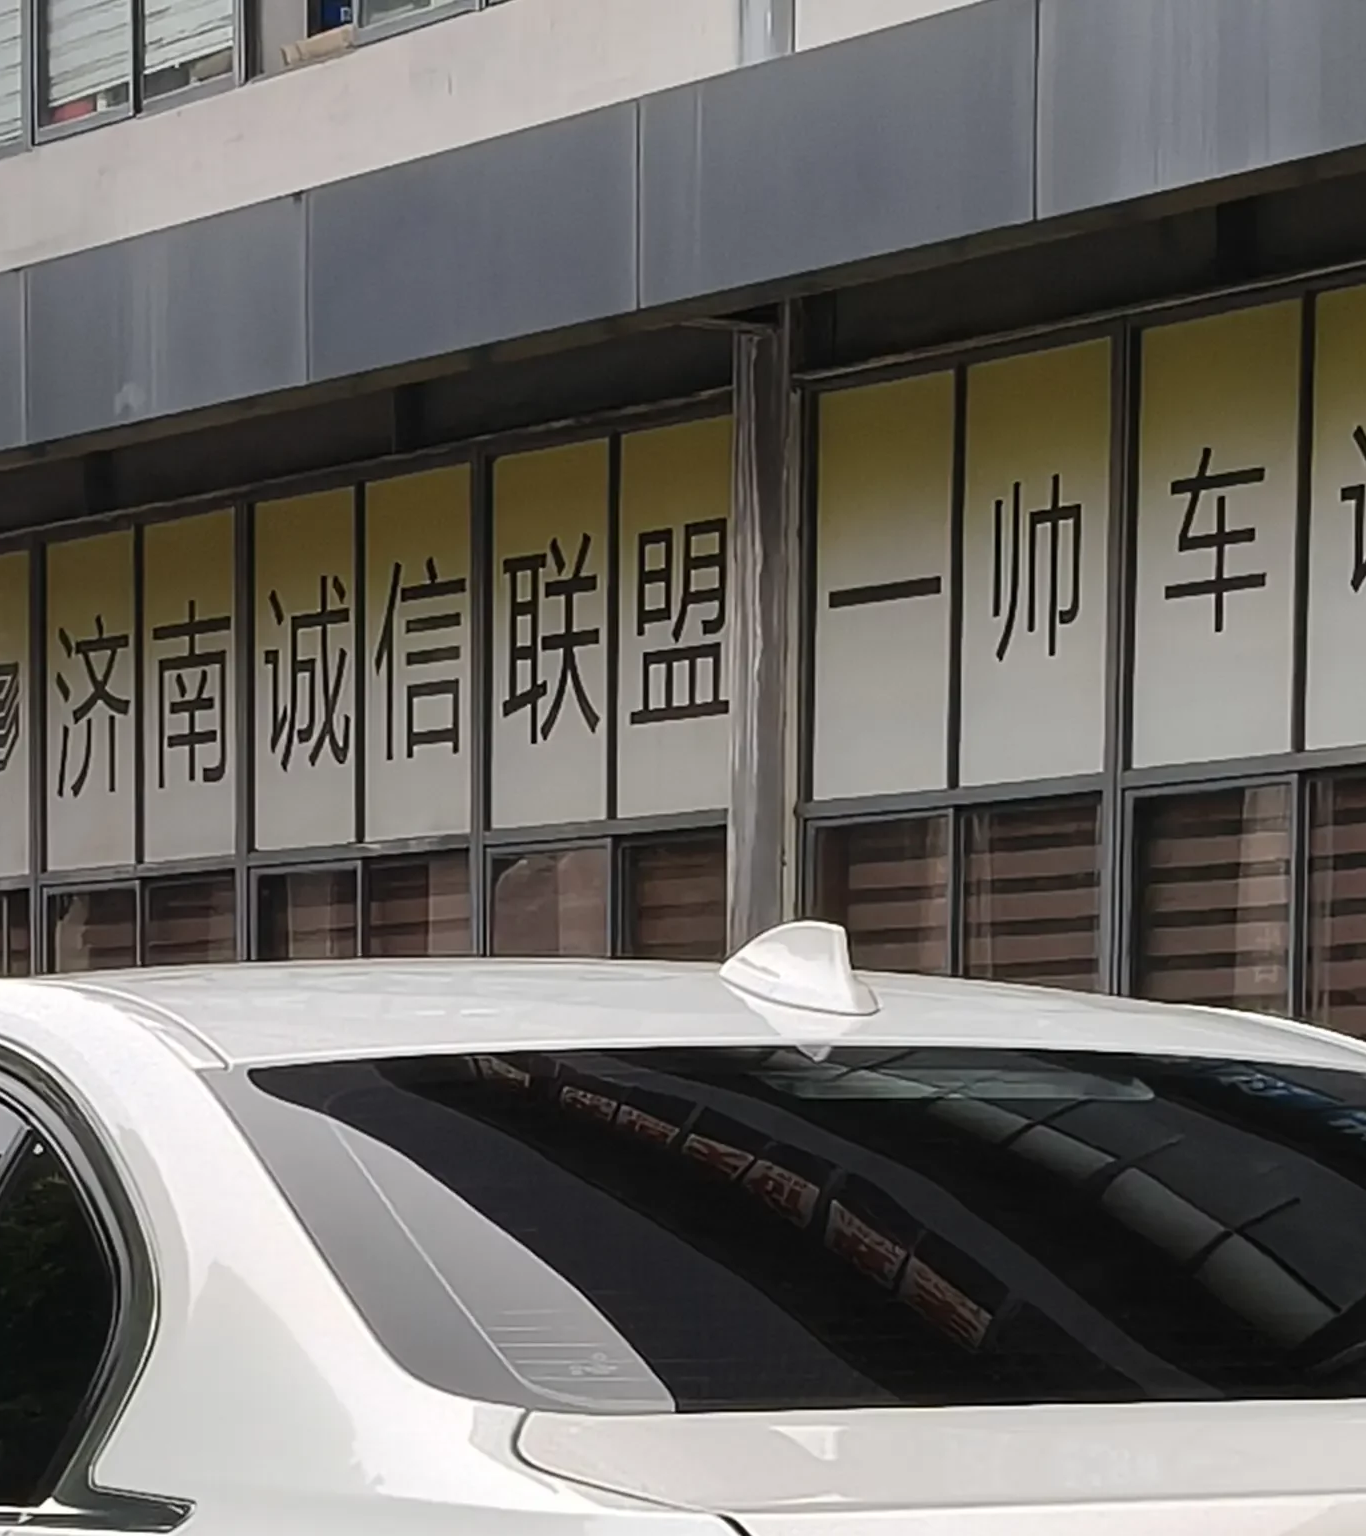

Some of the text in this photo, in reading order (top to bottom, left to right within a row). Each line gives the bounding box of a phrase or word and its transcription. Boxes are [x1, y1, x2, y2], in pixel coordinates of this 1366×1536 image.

[55, 517, 730, 798] 济南诚信联盟
